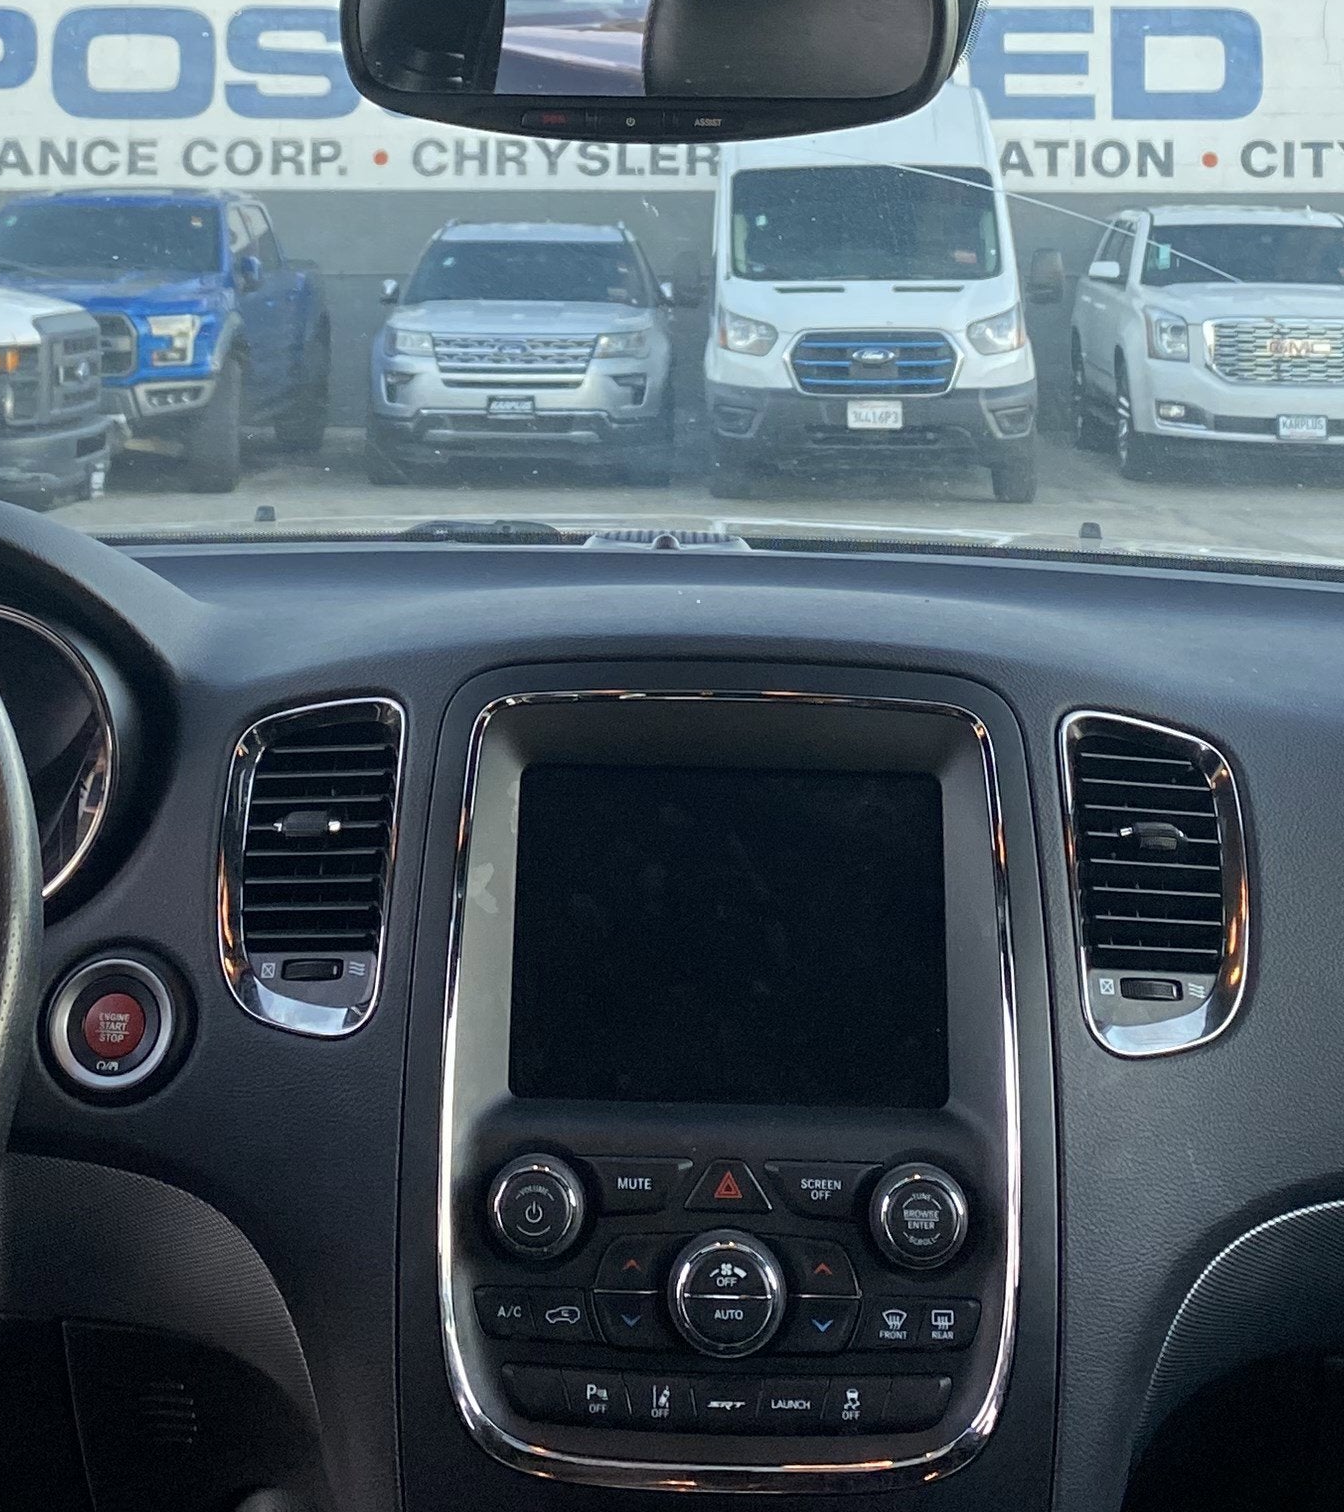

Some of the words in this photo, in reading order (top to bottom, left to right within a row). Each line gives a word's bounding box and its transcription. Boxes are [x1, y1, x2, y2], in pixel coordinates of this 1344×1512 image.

[693, 117, 723, 128] ASSIST
[182, 139, 349, 178] CORP.
[412, 139, 720, 178] CHRYSLER
[98, 1012, 131, 1023] ENGINE
[99, 1021, 128, 1032] START
[99, 1032, 125, 1043] STOP
[617, 1177, 652, 1191] MUTE
[800, 1178, 842, 1193] SCREEN
[810, 1189, 832, 1201] OFF
[911, 1192, 932, 1202] TUNE
[903, 1209, 940, 1219] BROWSE
[907, 1221, 936, 1230] ENTER
[716, 1276, 737, 1288] OFF
[497, 1305, 523, 1319] A/C
[714, 1309, 744, 1321] AUTO
[878, 1329, 907, 1340] FRONT
[931, 1330, 954, 1341] REAR
[588, 1402, 607, 1414] OFF
[706, 1400, 746, 1411] SRT
[770, 1398, 812, 1411] LAUNCH
[650, 1407, 670, 1419] OFF
[841, 1410, 861, 1421] OFF
